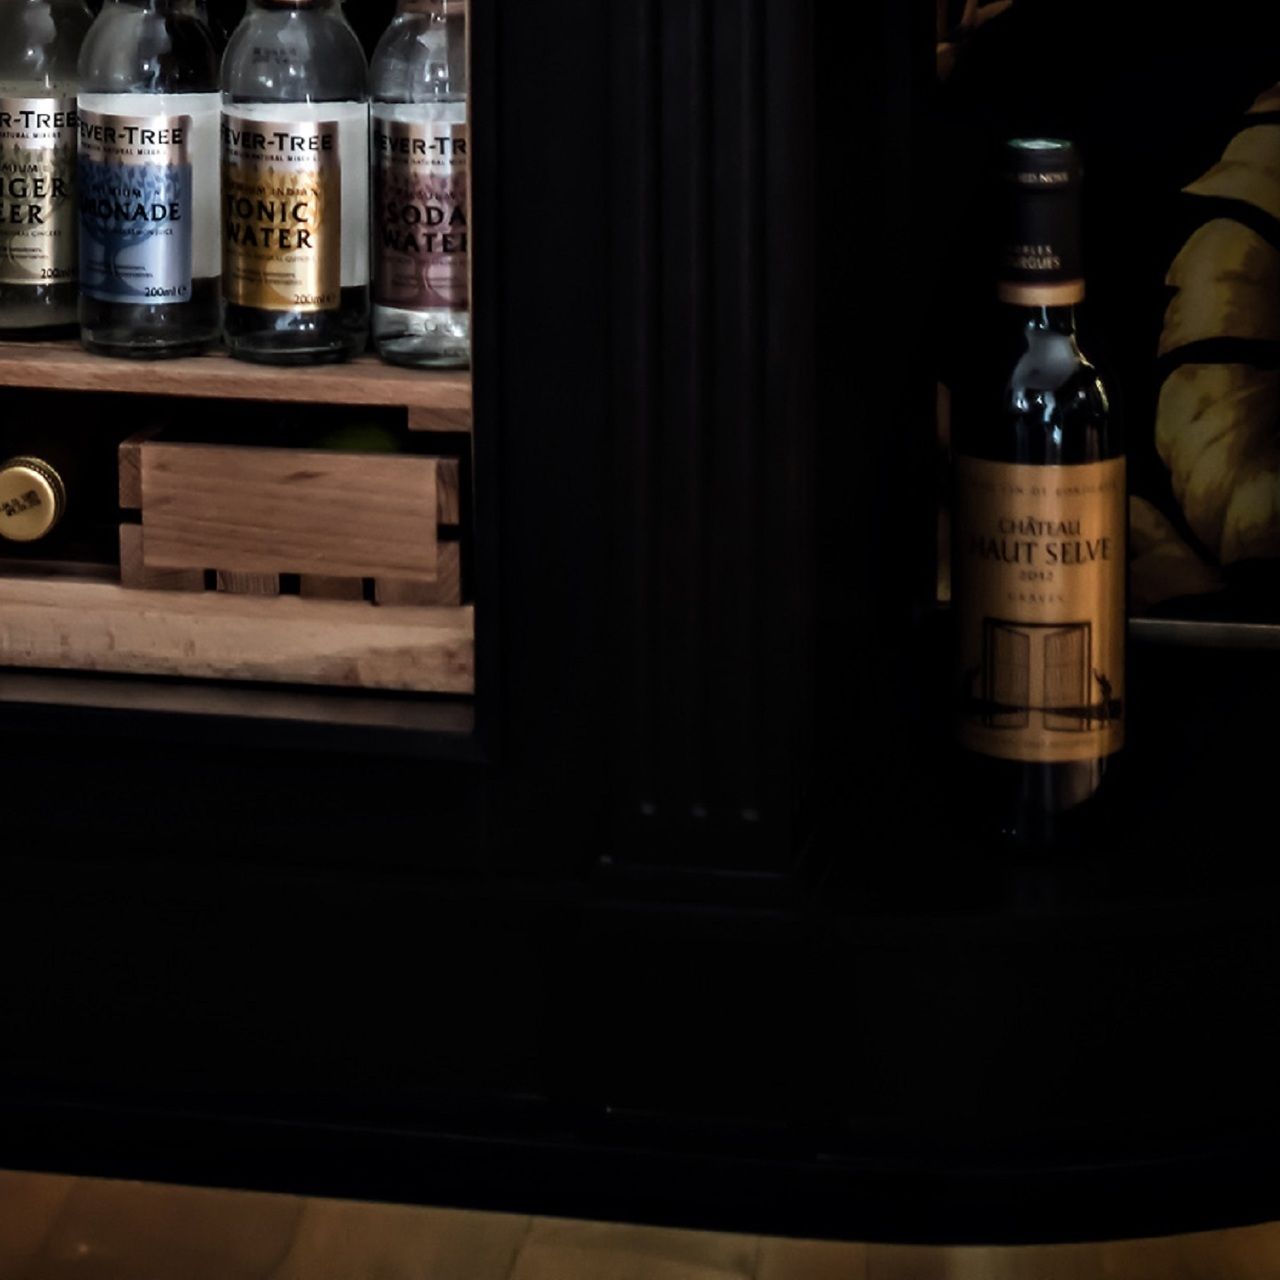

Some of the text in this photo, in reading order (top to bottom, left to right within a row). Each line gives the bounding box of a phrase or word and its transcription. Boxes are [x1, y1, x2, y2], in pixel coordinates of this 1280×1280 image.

[79, 120, 183, 146] EVER-TREE
[225, 195, 308, 223] TONIC
[386, 201, 468, 226] SODA
[226, 220, 313, 249] WATER
[997, 515, 1082, 537] CHÂTEAU
[1045, 537, 1113, 565] SELVE
